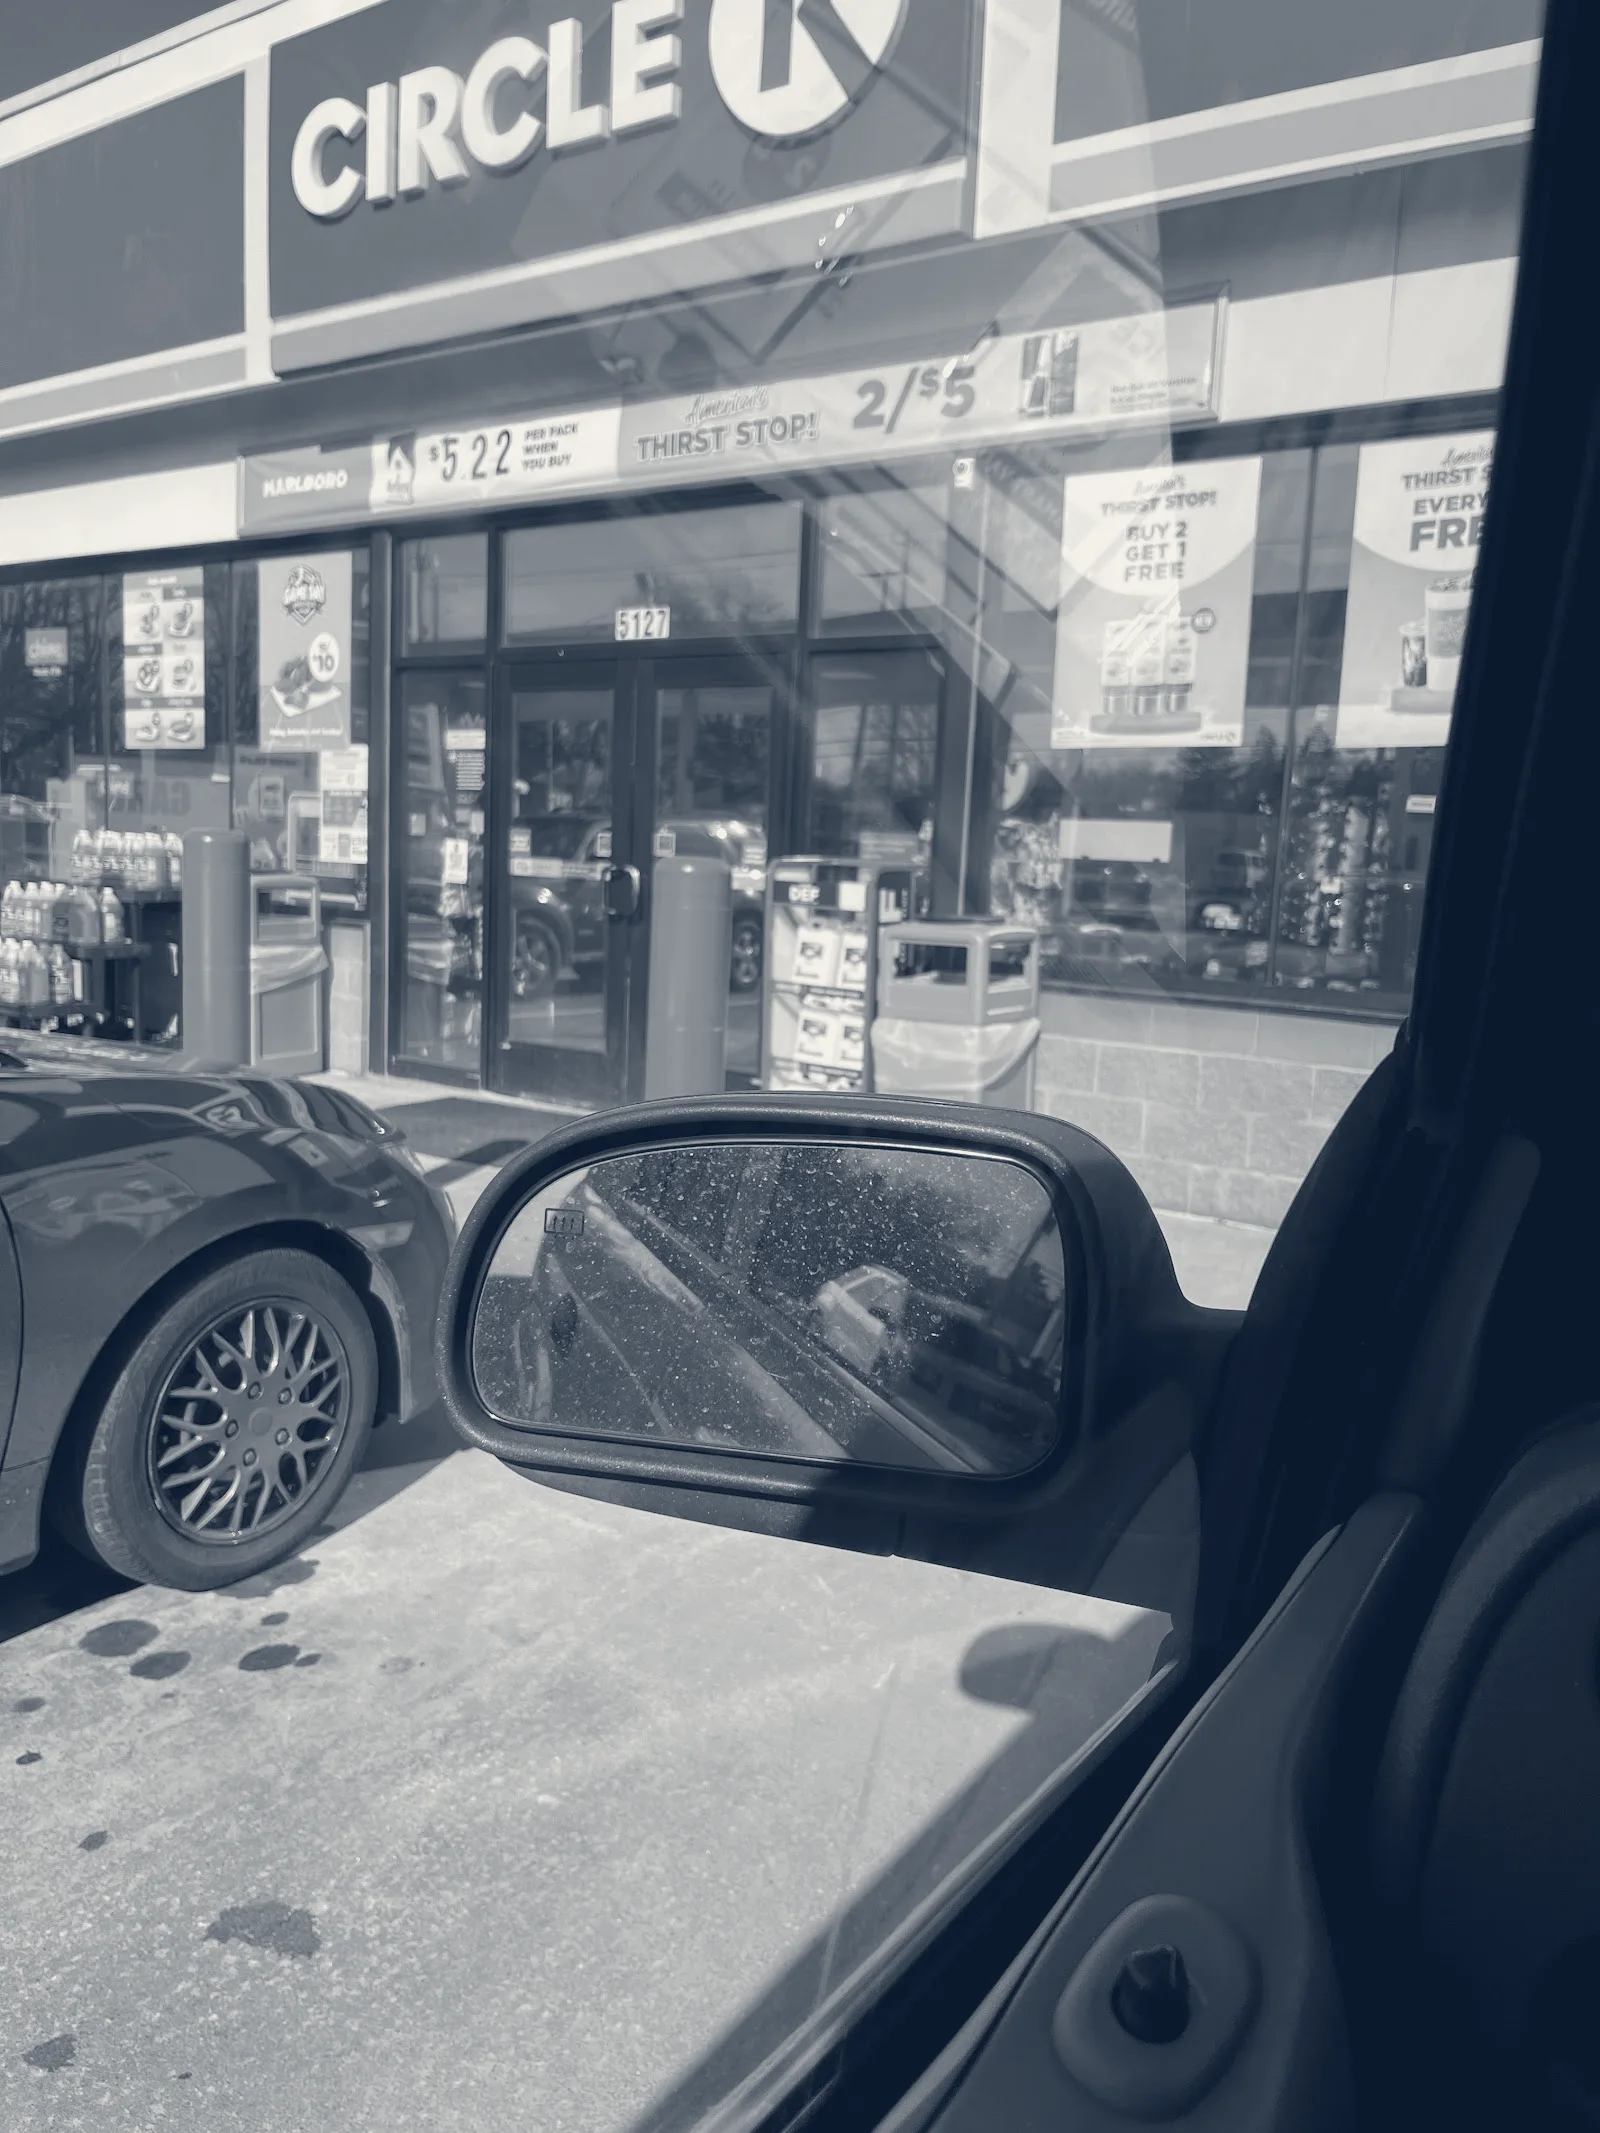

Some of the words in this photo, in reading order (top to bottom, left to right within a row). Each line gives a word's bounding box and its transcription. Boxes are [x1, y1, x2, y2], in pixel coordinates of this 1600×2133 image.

[291, 0, 683, 216] CIRCLE
[524, 428, 547, 442] PER
[549, 422, 579, 438] PACK
[636, 426, 727, 461] THIRST
[735, 411, 817, 446] STOP!
[522, 440, 559, 455] WHEN
[521, 457, 546, 472] YOU
[547, 452, 572, 468] BUY
[263, 468, 348, 498] MARLBORO
[1402, 466, 1474, 491] THIRST
[1101, 497, 1160, 517] THIRST
[1126, 522, 1170, 542] BUY
[1174, 520, 1189, 539] 2
[1410, 516, 1482, 552] FRE
[1125, 543, 1170, 562] GET
[1178, 541, 1187, 558] 1
[1124, 562, 1186, 582] FREE
[619, 610, 667, 639] 5127
